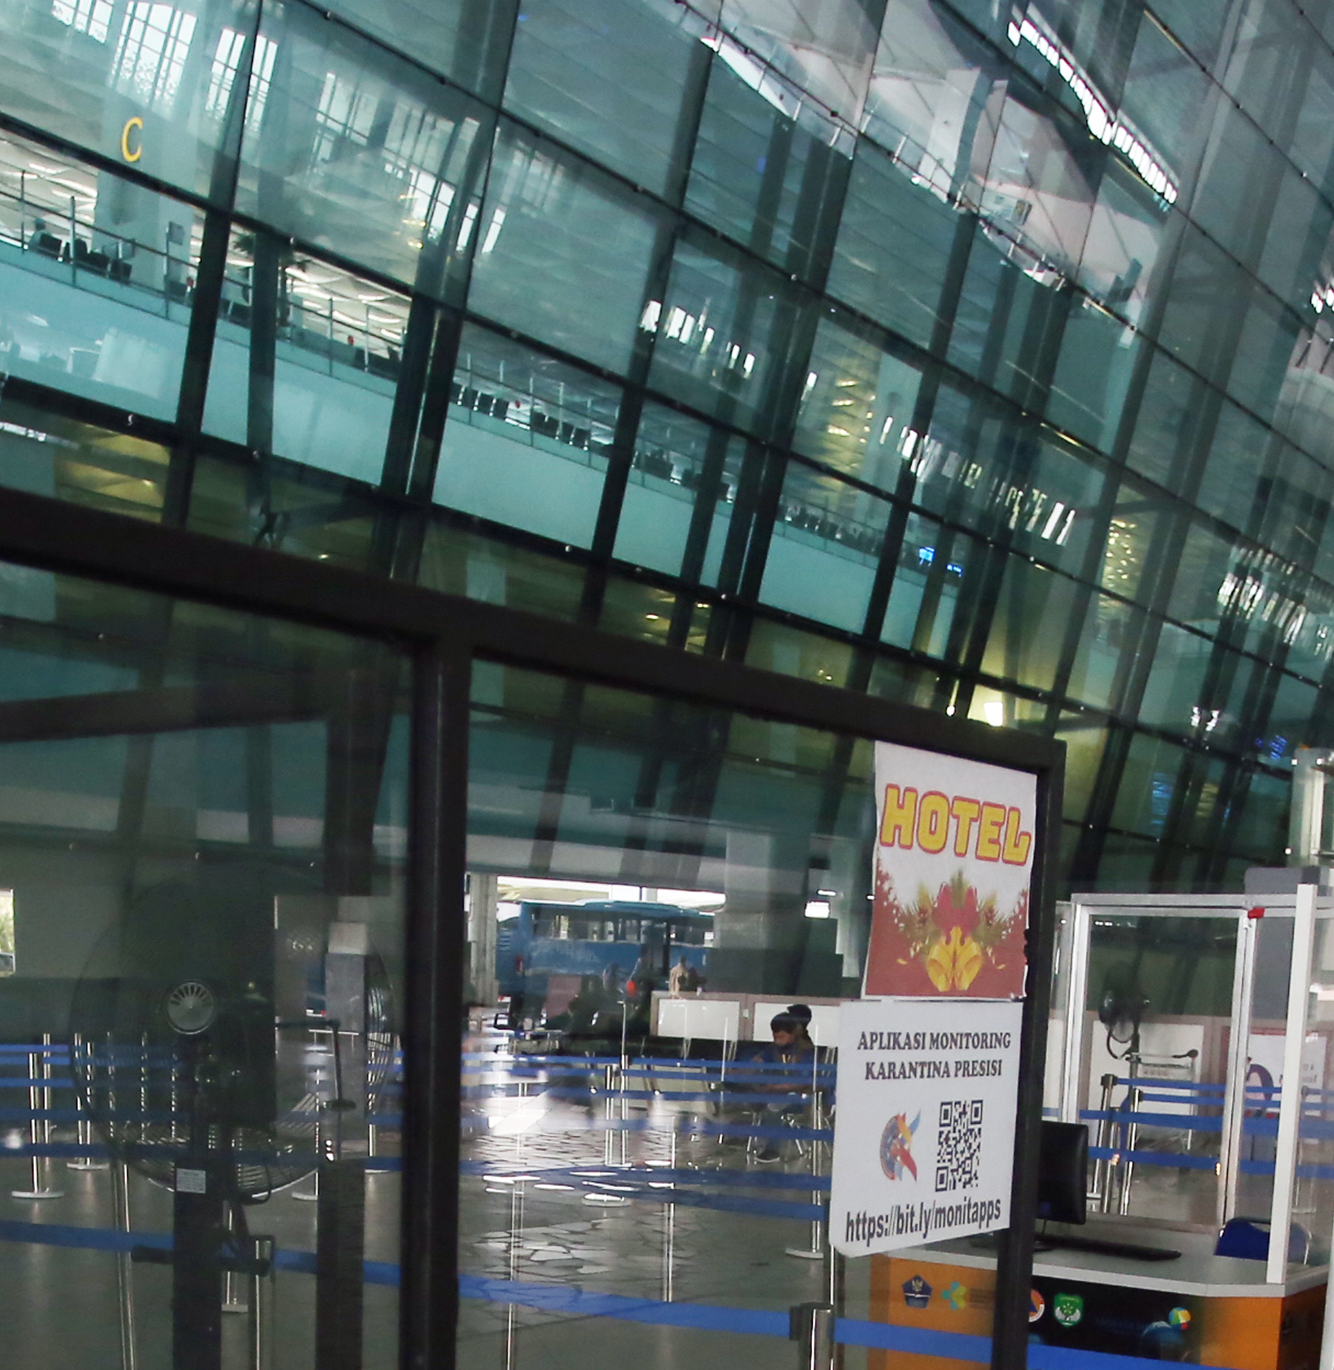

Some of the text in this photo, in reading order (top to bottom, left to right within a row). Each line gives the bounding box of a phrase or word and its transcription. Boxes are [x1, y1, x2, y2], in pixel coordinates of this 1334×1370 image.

[121, 116, 144, 163] C
[879, 783, 1033, 866] HOTEL
[857, 1030, 1012, 1052] APLIKASI MONITORING
[864, 1059, 1003, 1081] KARANTINA PRESISI
[845, 1195, 1002, 1249] https://bit.ly/monitapps
